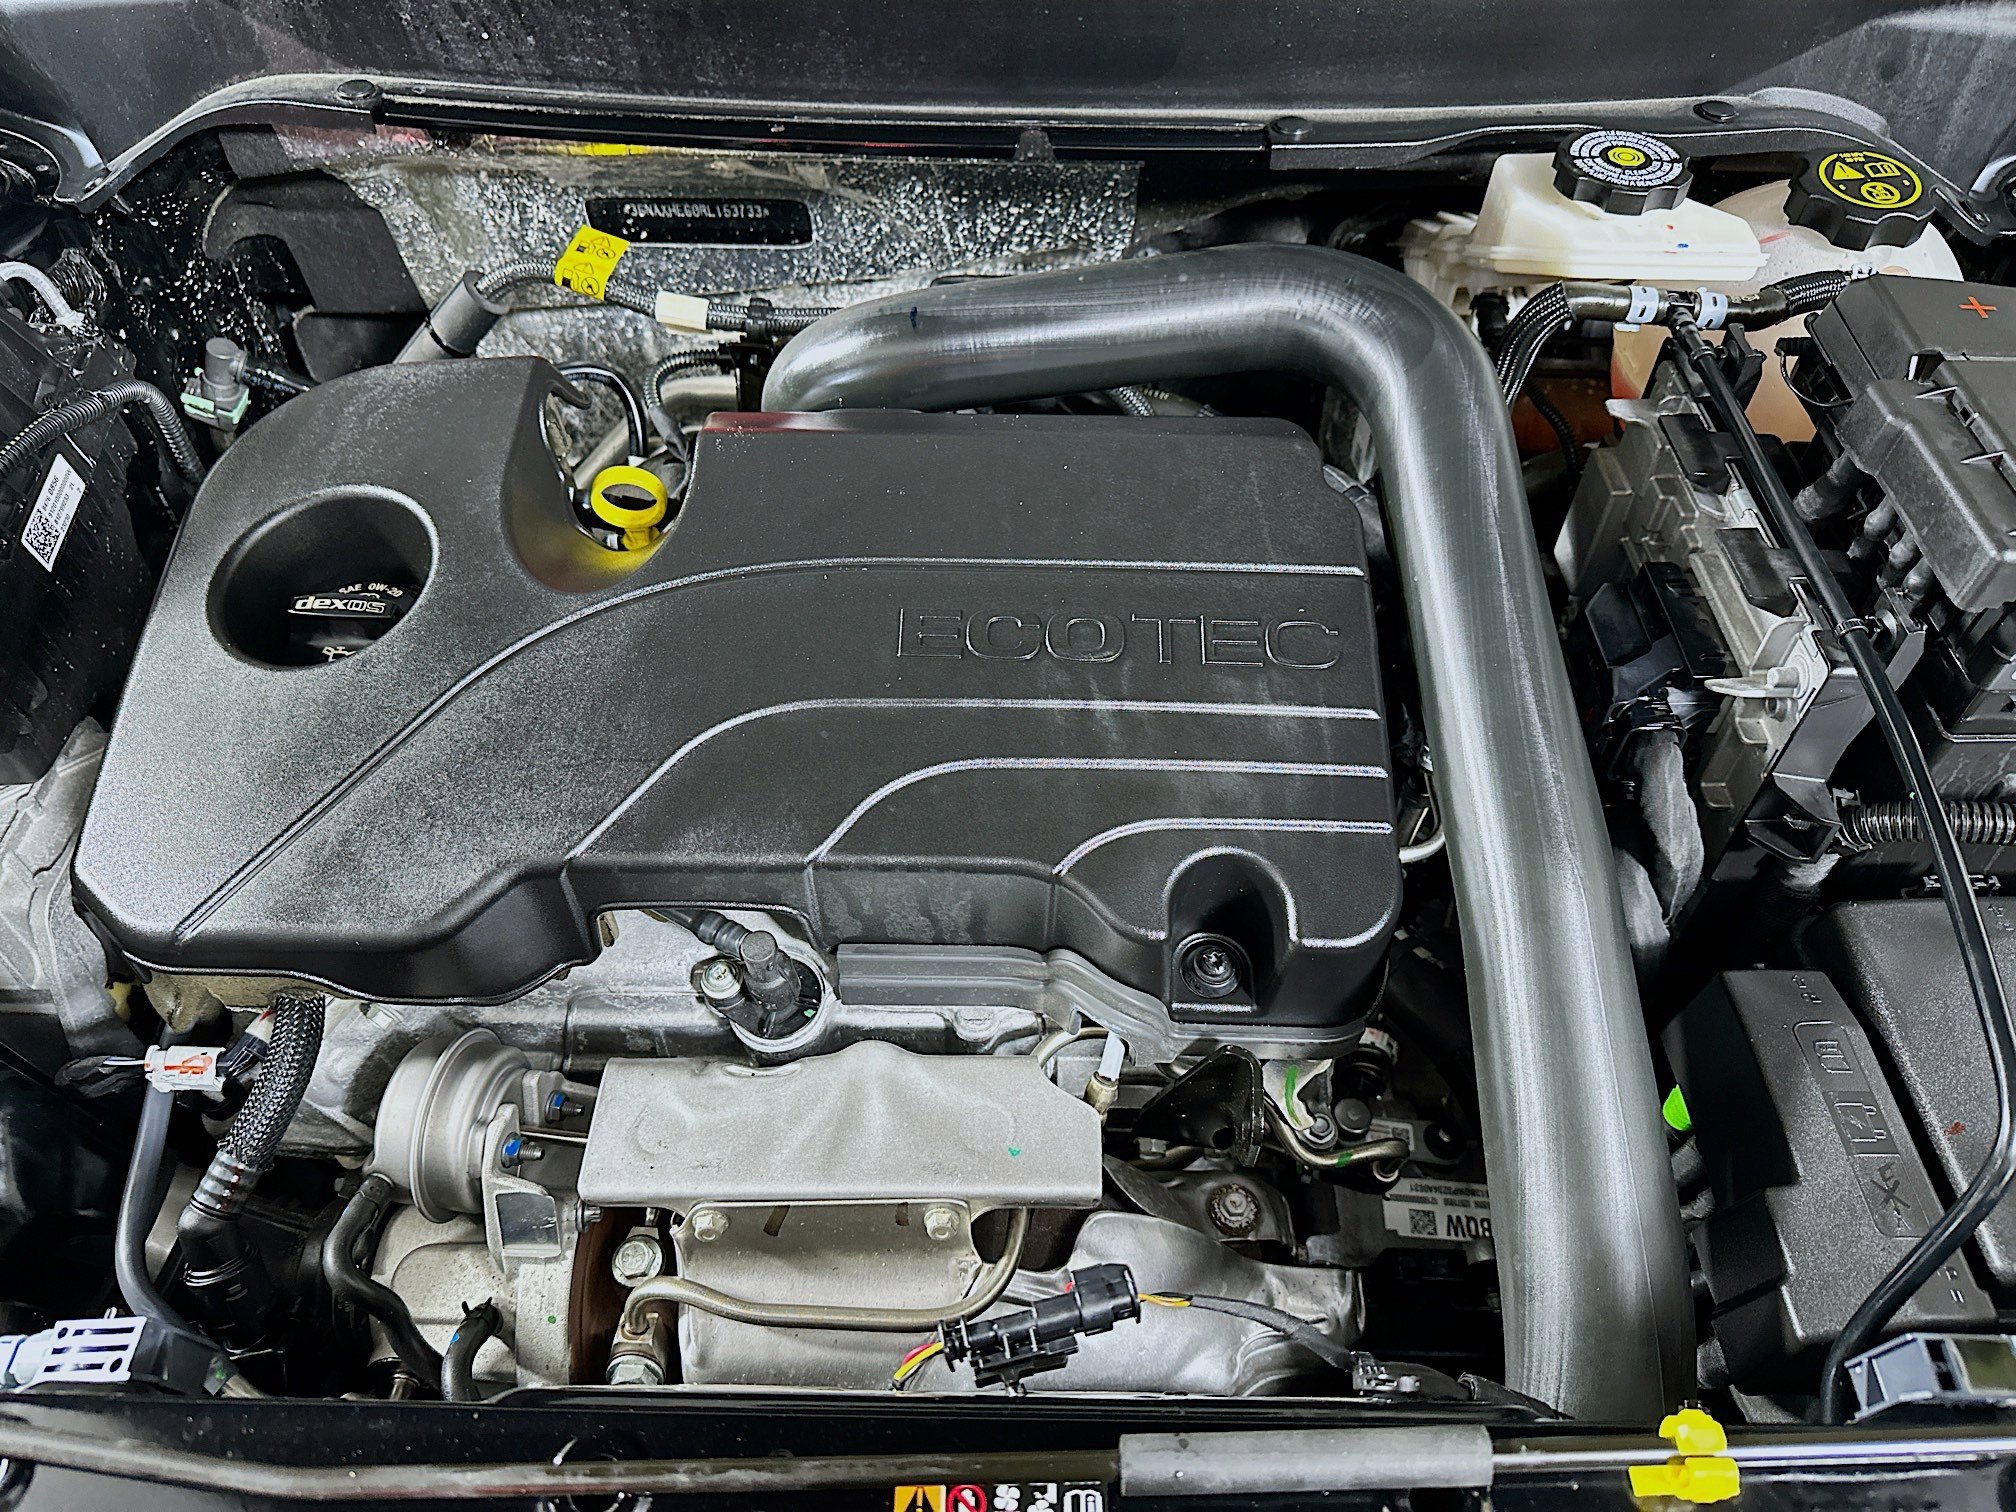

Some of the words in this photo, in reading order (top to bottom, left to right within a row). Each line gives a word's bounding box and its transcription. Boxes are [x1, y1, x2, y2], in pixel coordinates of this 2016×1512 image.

[48, 475, 59, 496] 0856
[338, 583, 363, 594] SAE
[367, 582, 403, 598] 0W-20
[294, 596, 386, 613] dexos
[897, 607, 1340, 670] ECOTEC
